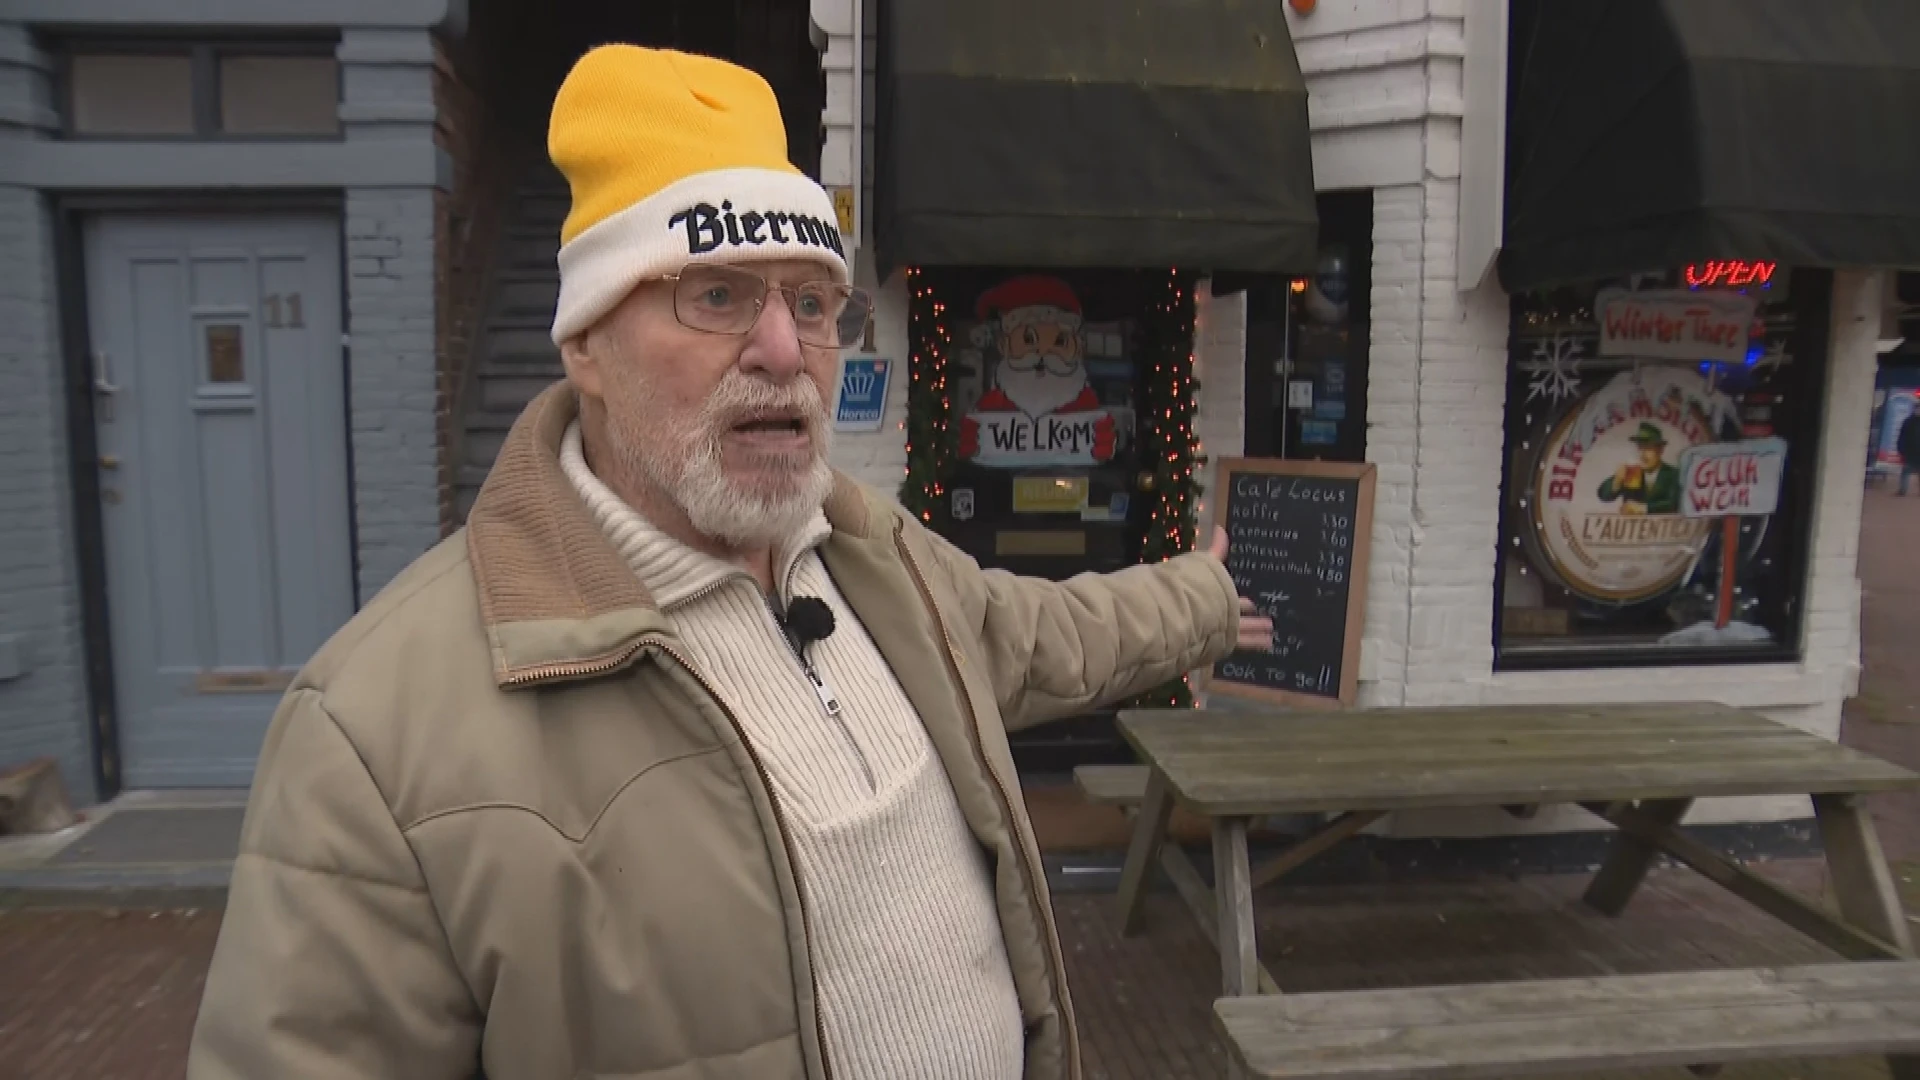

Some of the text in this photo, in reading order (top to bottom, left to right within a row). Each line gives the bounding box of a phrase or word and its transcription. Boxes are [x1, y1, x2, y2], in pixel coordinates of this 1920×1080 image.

[1686, 260, 1776, 286] OPEN
[263, 293, 306, 329] 11
[1605, 304, 1740, 348] Winter Thee
[839, 408, 879, 421] Horeca
[986, 417, 1091, 453] WELKOM
[1288, 478, 1345, 502] Locus
